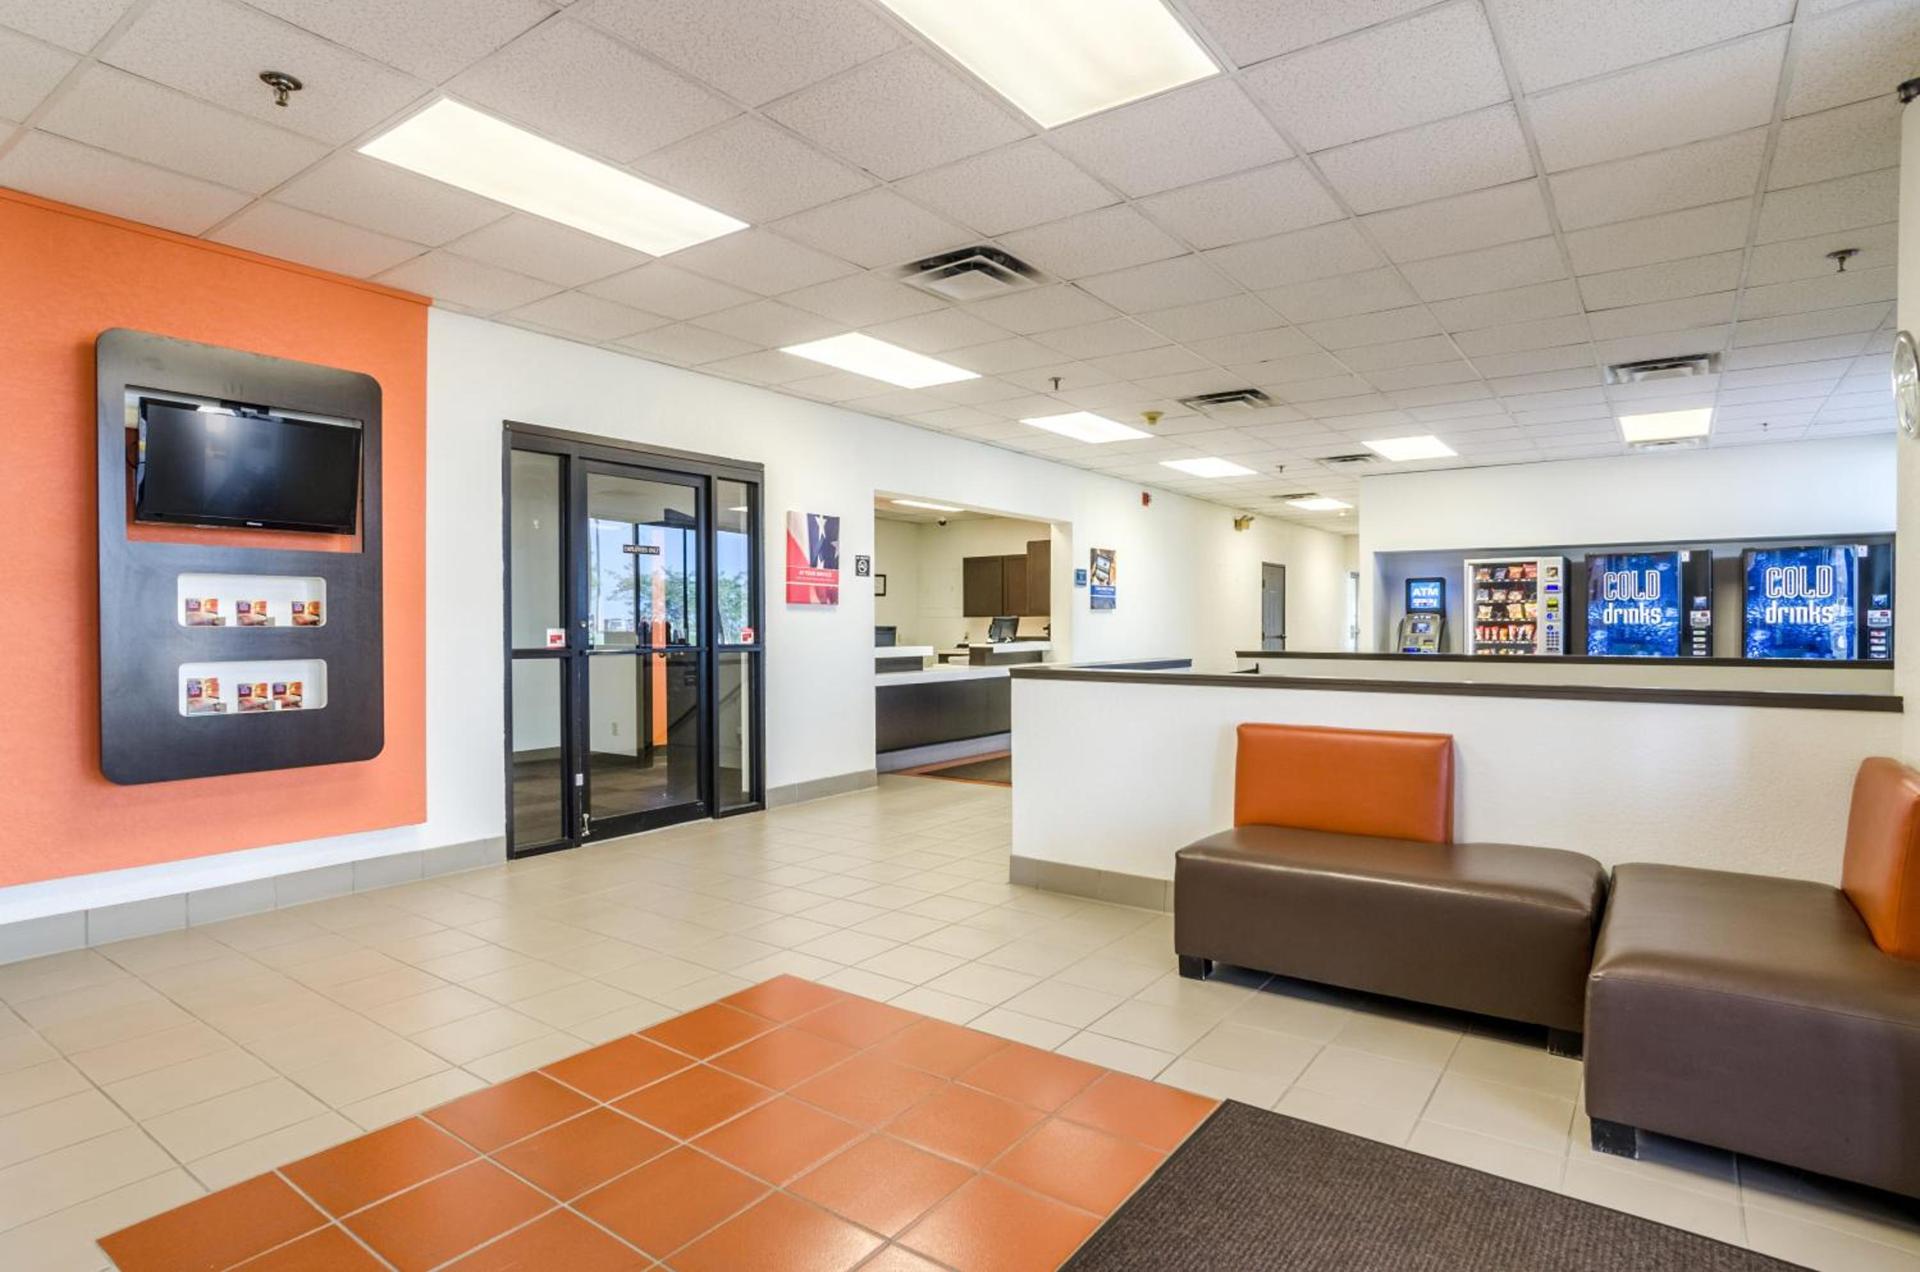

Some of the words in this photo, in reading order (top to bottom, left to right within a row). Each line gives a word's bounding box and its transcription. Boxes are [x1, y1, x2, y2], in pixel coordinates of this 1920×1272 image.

[1413, 588, 1439, 596] ATM
[1603, 569, 1660, 601] COLD
[1766, 565, 1833, 598] COLD
[1603, 602, 1662, 625] drinks
[1765, 599, 1834, 624] drinks
